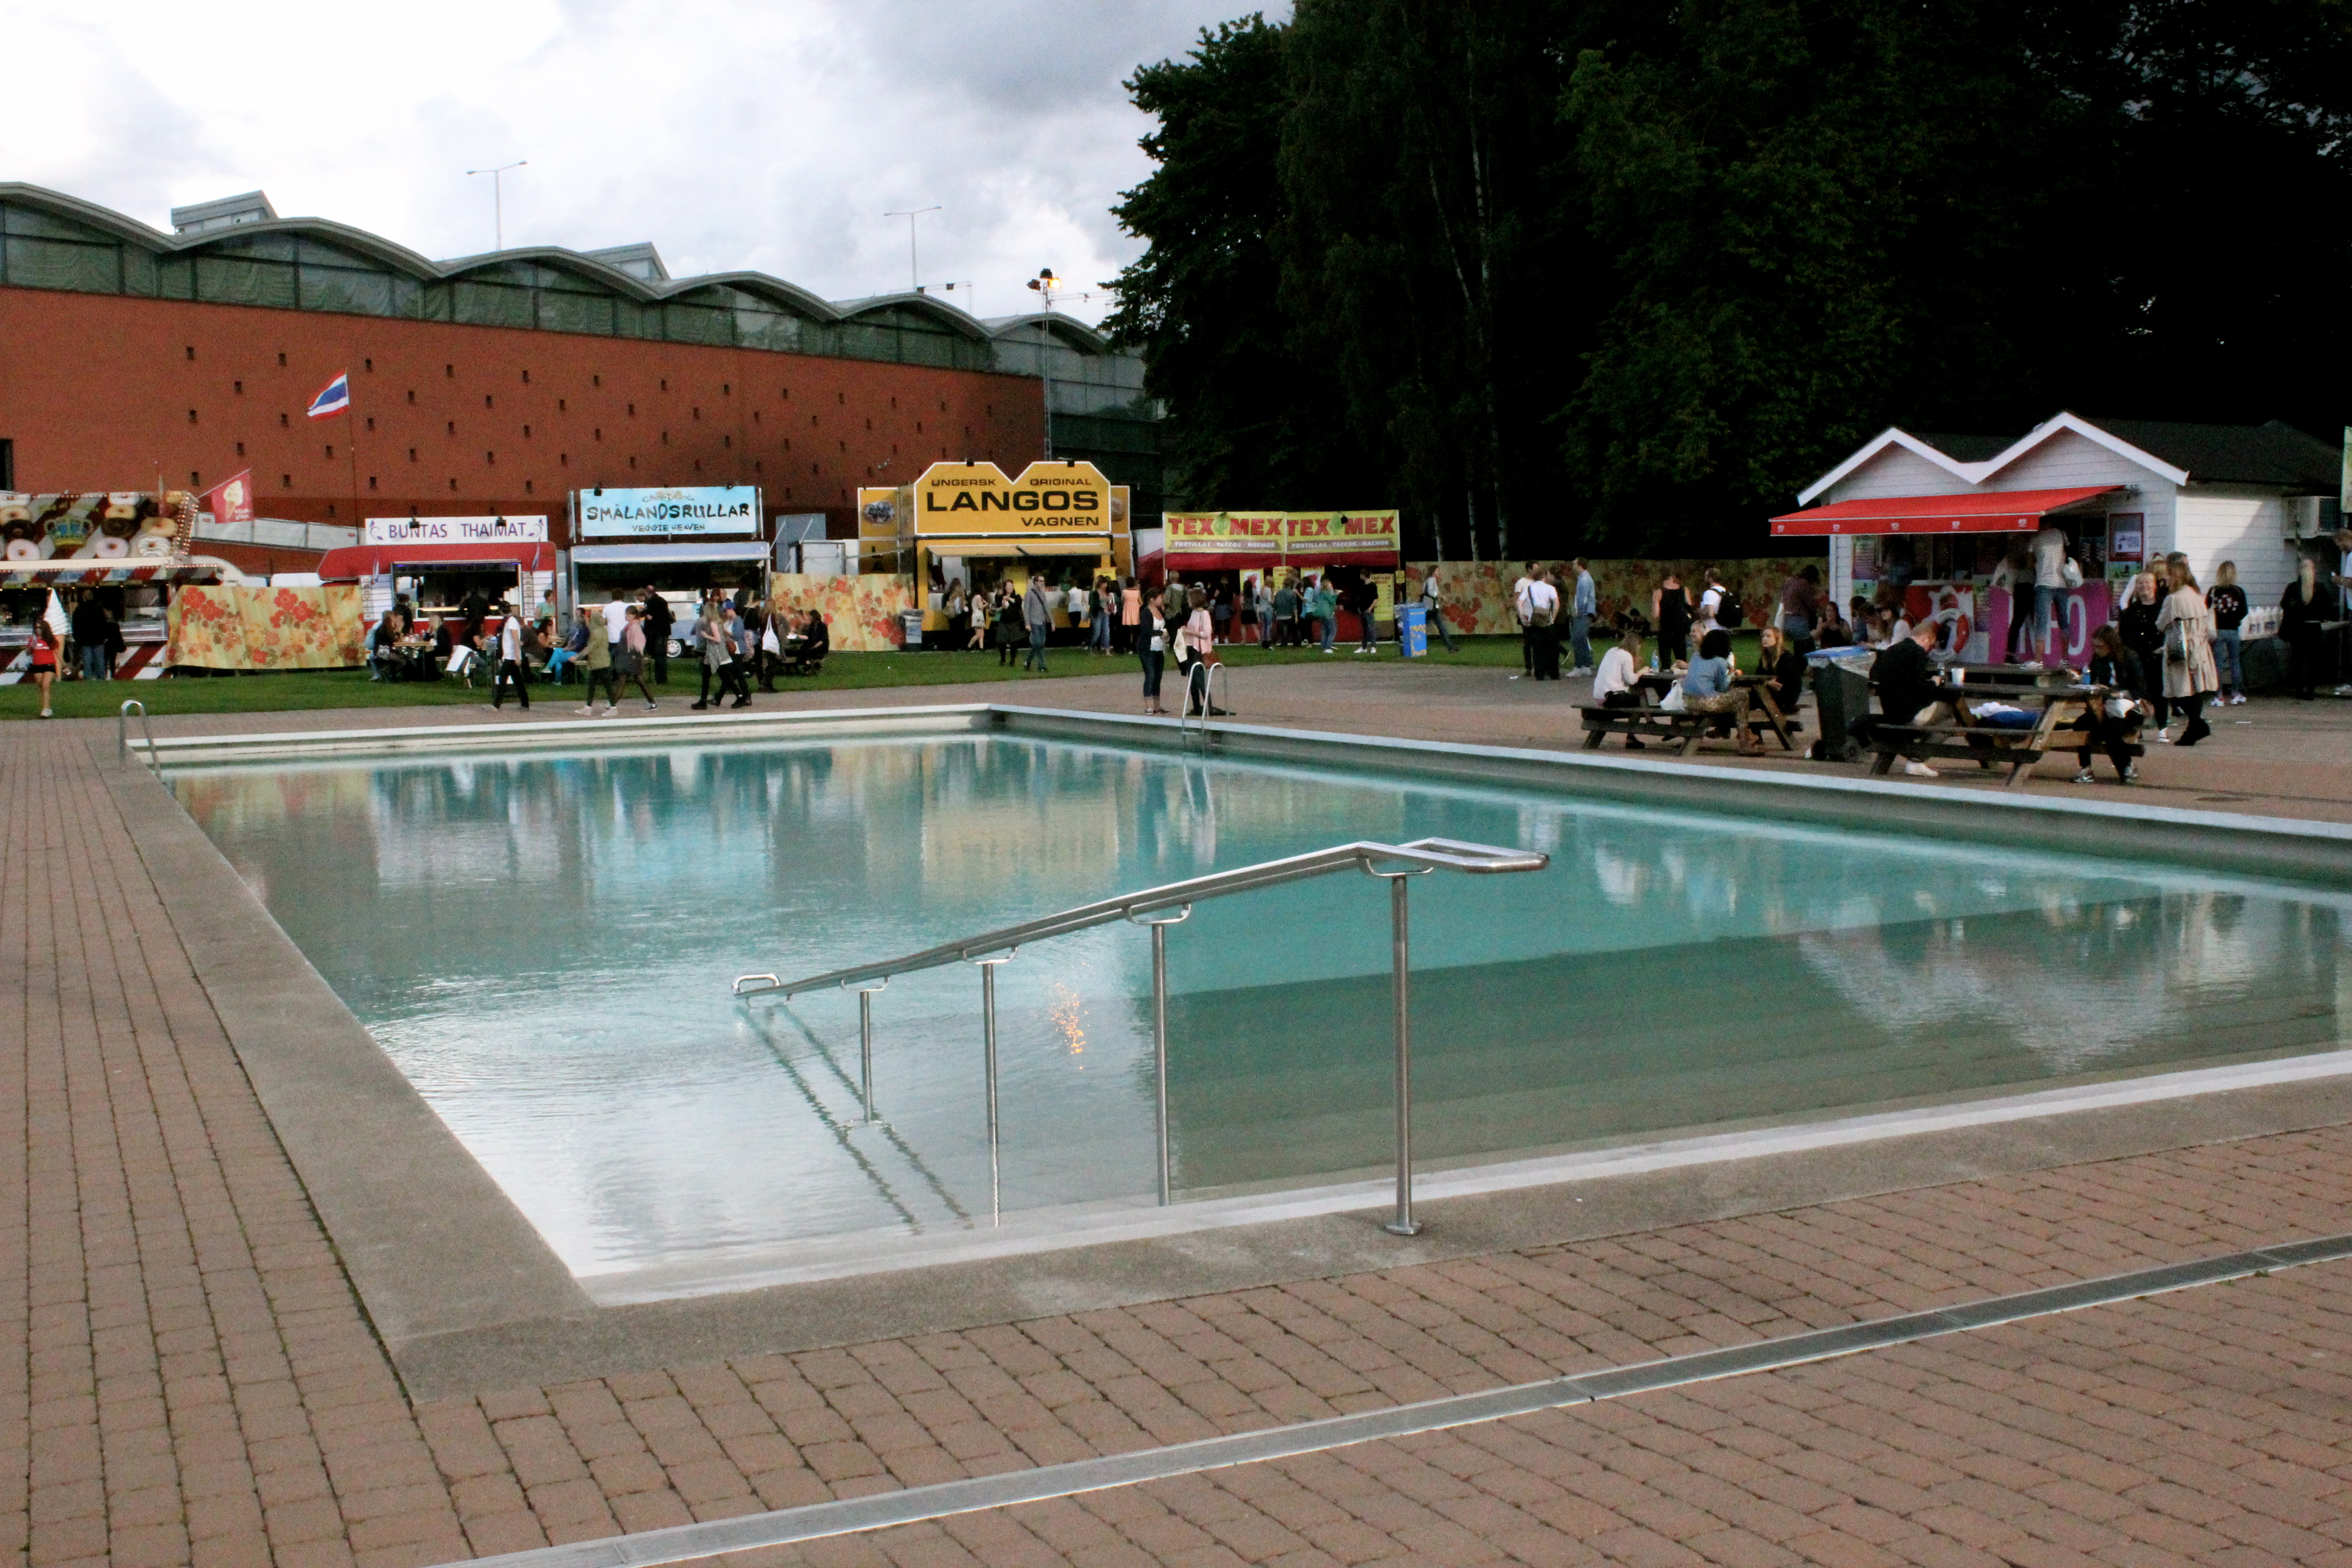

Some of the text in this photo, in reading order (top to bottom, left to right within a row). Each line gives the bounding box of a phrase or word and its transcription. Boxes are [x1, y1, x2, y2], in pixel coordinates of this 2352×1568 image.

[931, 479, 996, 487] UNGERSK
[926, 490, 1099, 512] LANGOS
[587, 503, 750, 522] SMÅLANDSRULLAR
[1021, 517, 1099, 526] VAGNEN
[1168, 518, 1282, 535] TEX MEX
[1287, 516, 1395, 536] TEX MEX
[389, 522, 526, 539] BUNTAS THAIMAT
